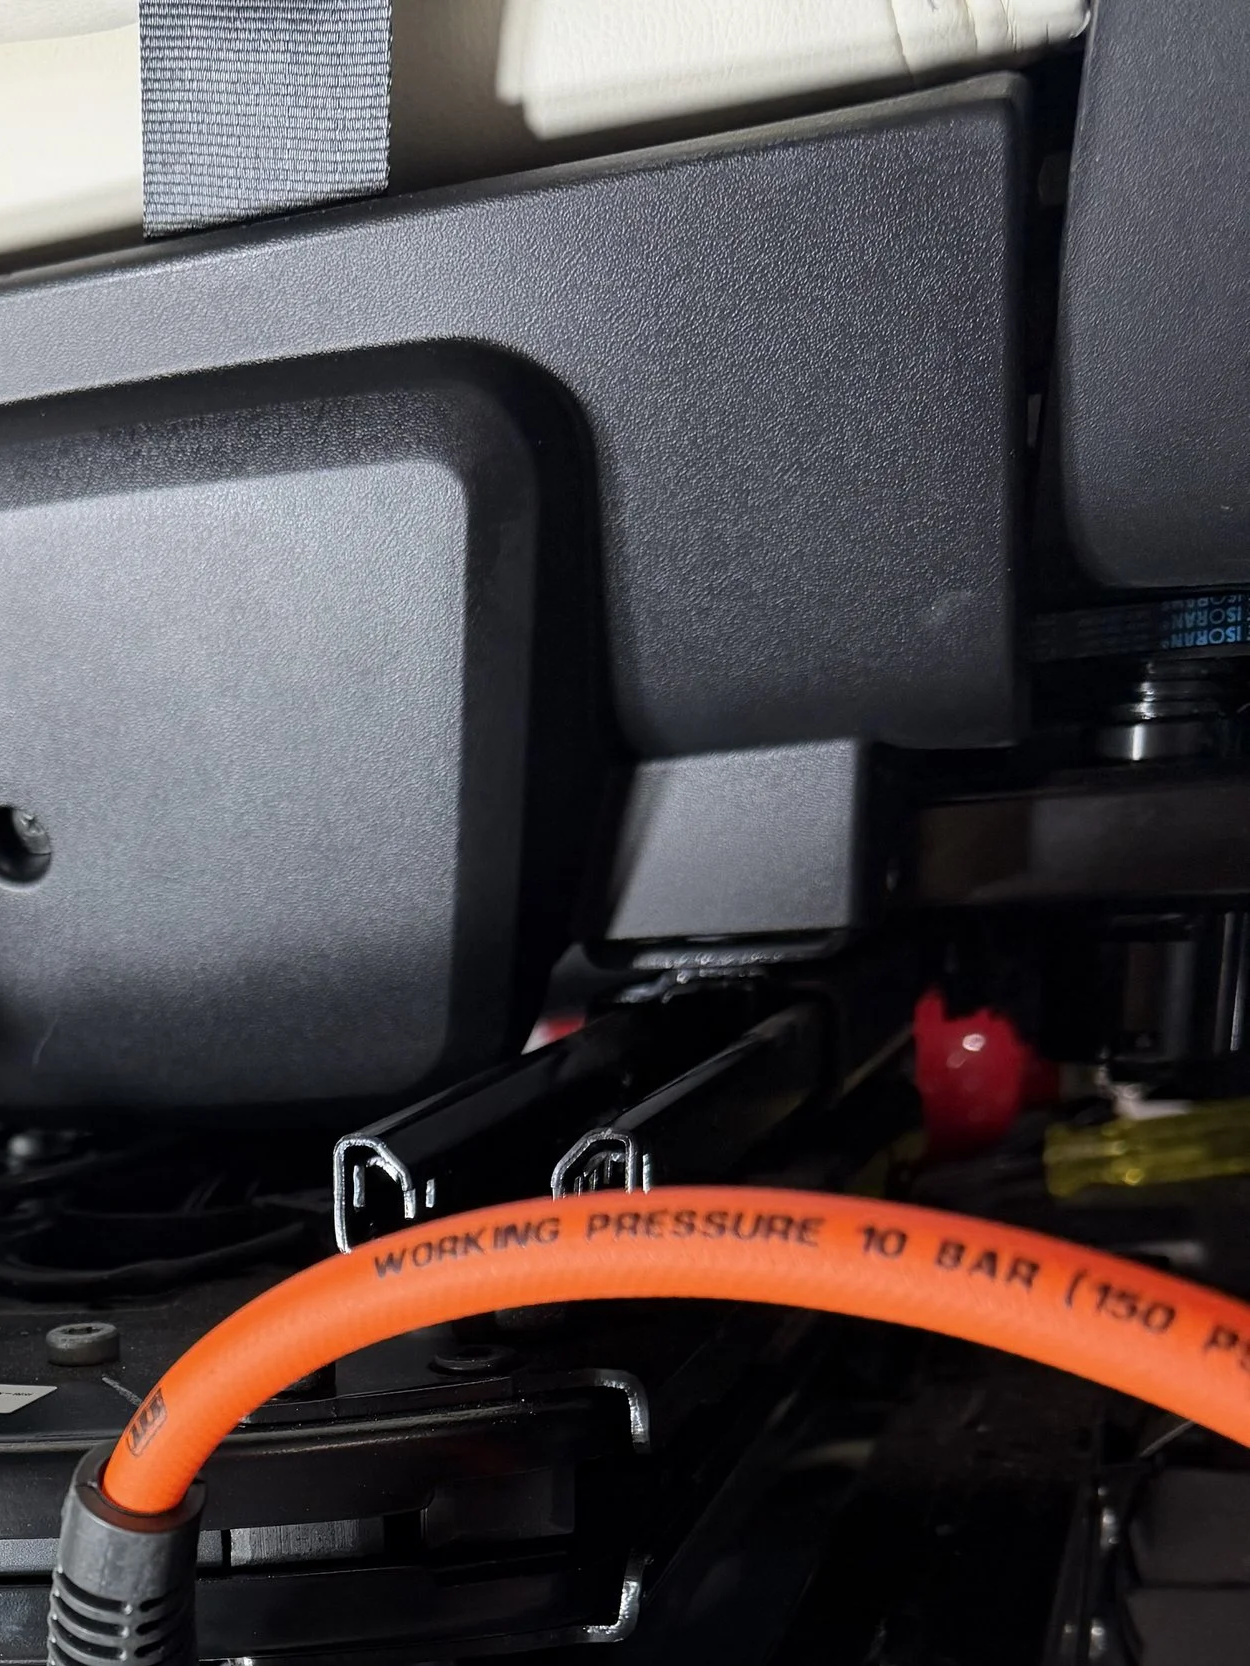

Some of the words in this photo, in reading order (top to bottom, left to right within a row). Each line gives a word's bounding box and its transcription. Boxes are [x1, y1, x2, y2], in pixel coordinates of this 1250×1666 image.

[374, 1217, 561, 1278] WORKING
[584, 1208, 827, 1247] PRESSURE
[859, 1226, 908, 1259] 10
[935, 1239, 1041, 1290] BAR
[1065, 1268, 1177, 1335] (150
